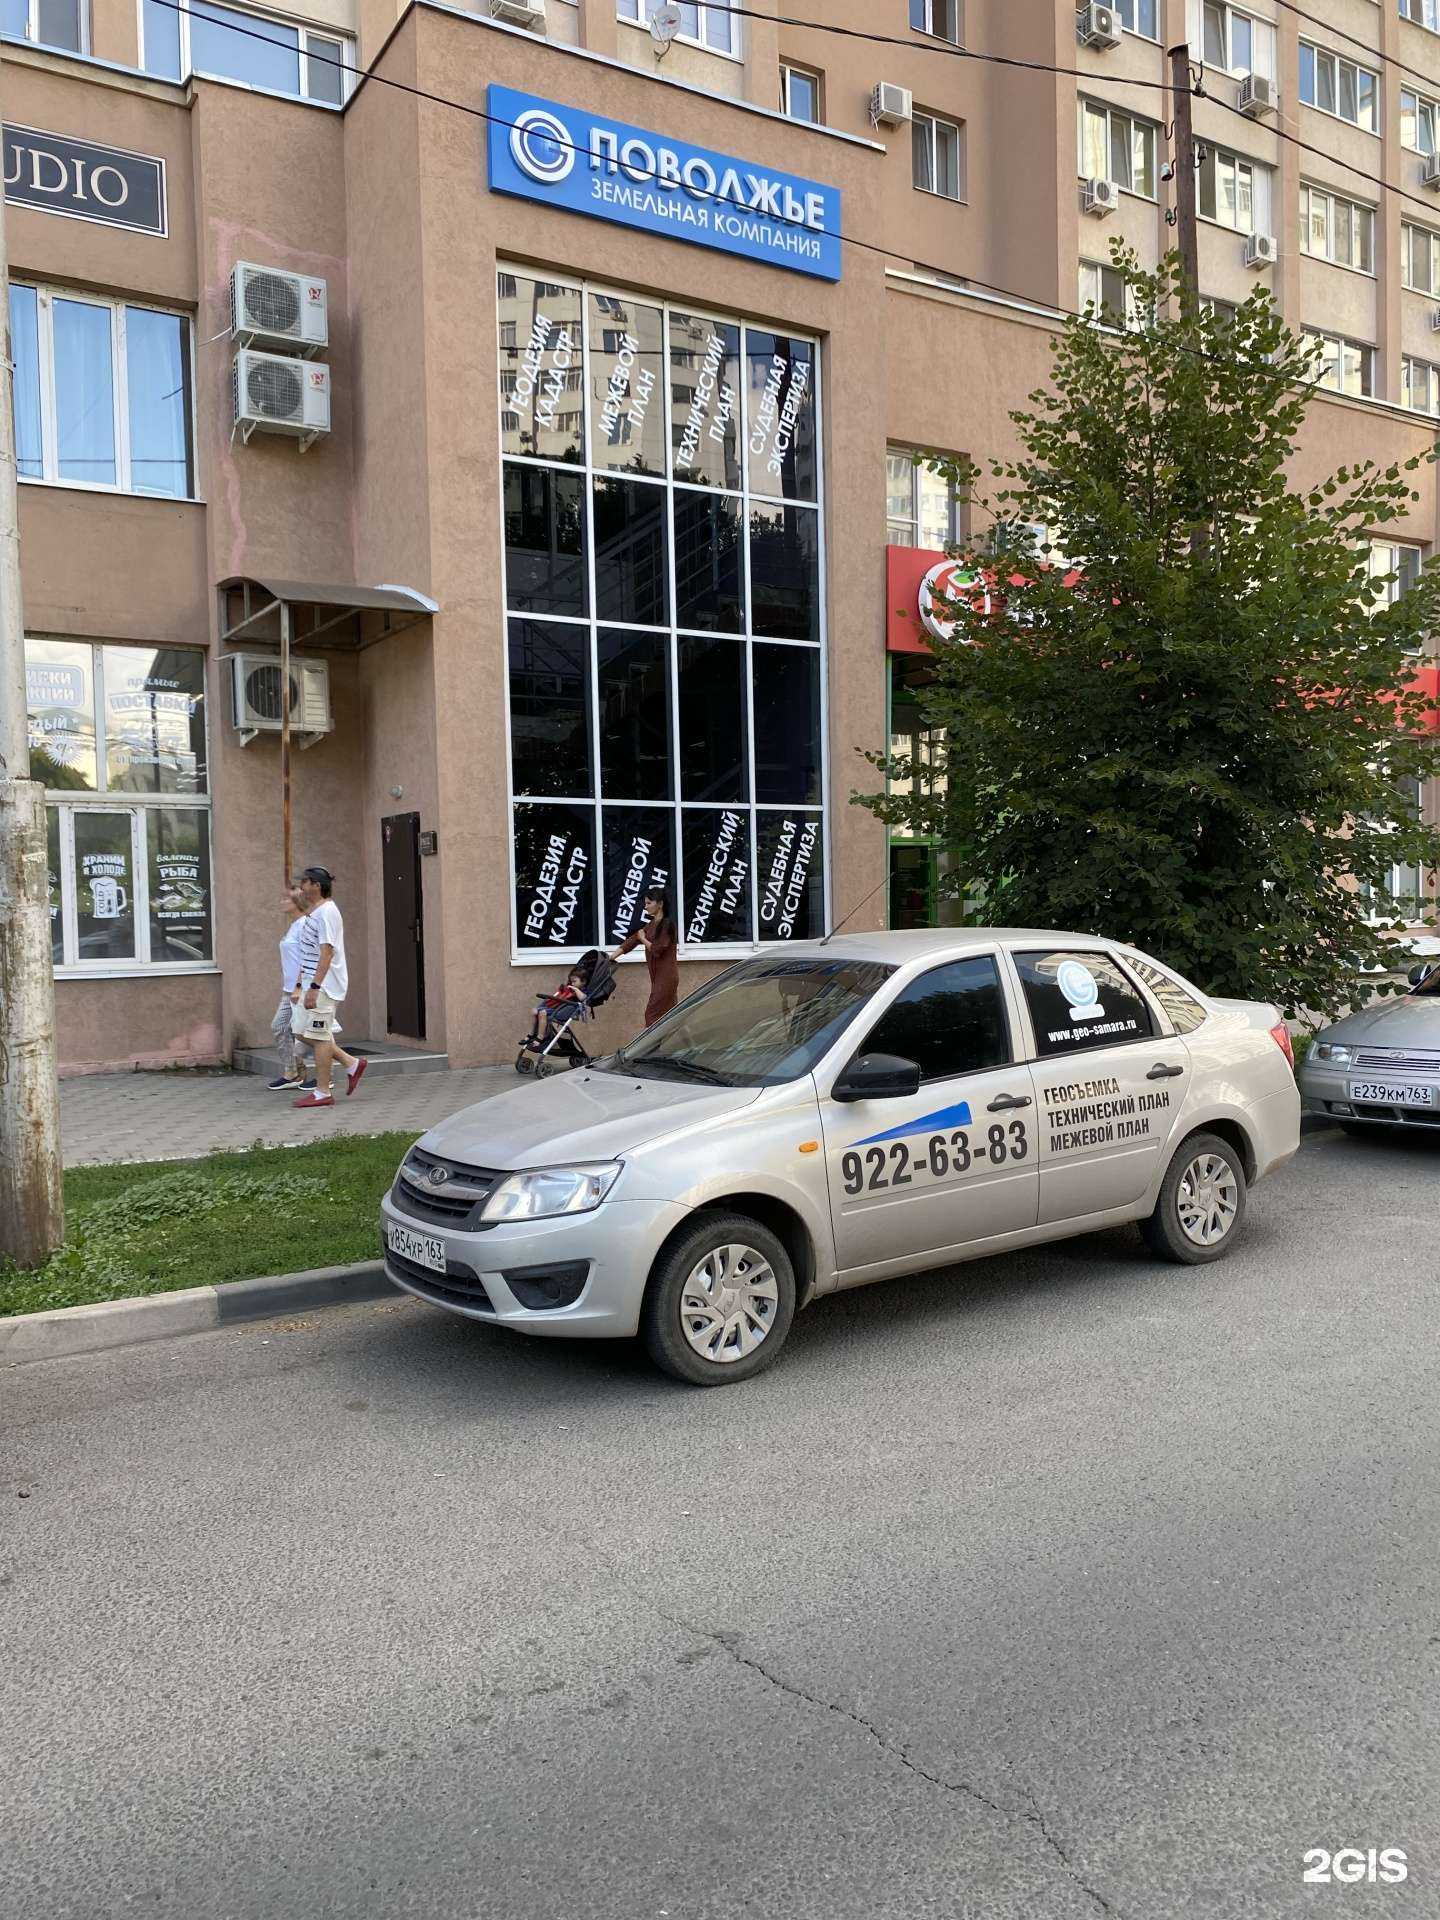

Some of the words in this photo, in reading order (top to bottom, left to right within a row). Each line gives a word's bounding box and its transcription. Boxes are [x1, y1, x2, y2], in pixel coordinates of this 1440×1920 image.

[589, 127, 825, 232] ПОВОЛЖЬЕ
[591, 178, 708, 228] ЗЕМЕЛЬНАЯ
[714, 214, 820, 259] КОМПАНИЯ
[509, 313, 552, 417] ГЕОДЕЗИЯ
[535, 331, 574, 427] КАДАСТР
[598, 332, 639, 437] МЕЖЕВОЙ
[627, 368, 655, 428] ПЛАН
[676, 334, 726, 468] ТЕХНИЧЕСКИЙ
[709, 385, 735, 443] ПЛАН
[750, 355, 787, 455] СУДЕБНАЯ
[767, 360, 810, 476] ЭКСПЕРТИЗА
[109, 695, 196, 714] ПОСТАВКИ
[82, 854, 125, 867] ХРАНИМ
[92, 863, 127, 876] ХОЛОДЕ
[160, 866, 198, 878] РЫБА
[524, 834, 567, 939] ГЕОДЕЗИЯ
[549, 847, 588, 944] КАДАСТР
[612, 837, 652, 940] МЕЖЕВОЙ
[640, 867, 668, 923] ПН
[686, 811, 741, 943] ТЕХНИЧЕСКИЙ
[720, 859, 748, 915] ПЛАН
[761, 820, 797, 921] СУДЕБНАЯ
[777, 822, 819, 939] ЭКСПЕРТИЗА
[1048, 1019, 1137, 1042] www.geo-samara.ru
[1044, 1078, 1120, 1105] ГЕОСЪЕМКА
[1048, 1094, 1135, 1128] ТЕХНИЧЕСКИЙ
[1138, 1091, 1170, 1112] ПЛАН
[1407, 1088, 1428, 1100] 763
[842, 1119, 1028, 1195] 922-63-83
[1050, 1121, 1113, 1152] МЕЖЕВОЙ
[1117, 1118, 1149, 1139] ПЛАН
[425, 1240, 442, 1261] 163
